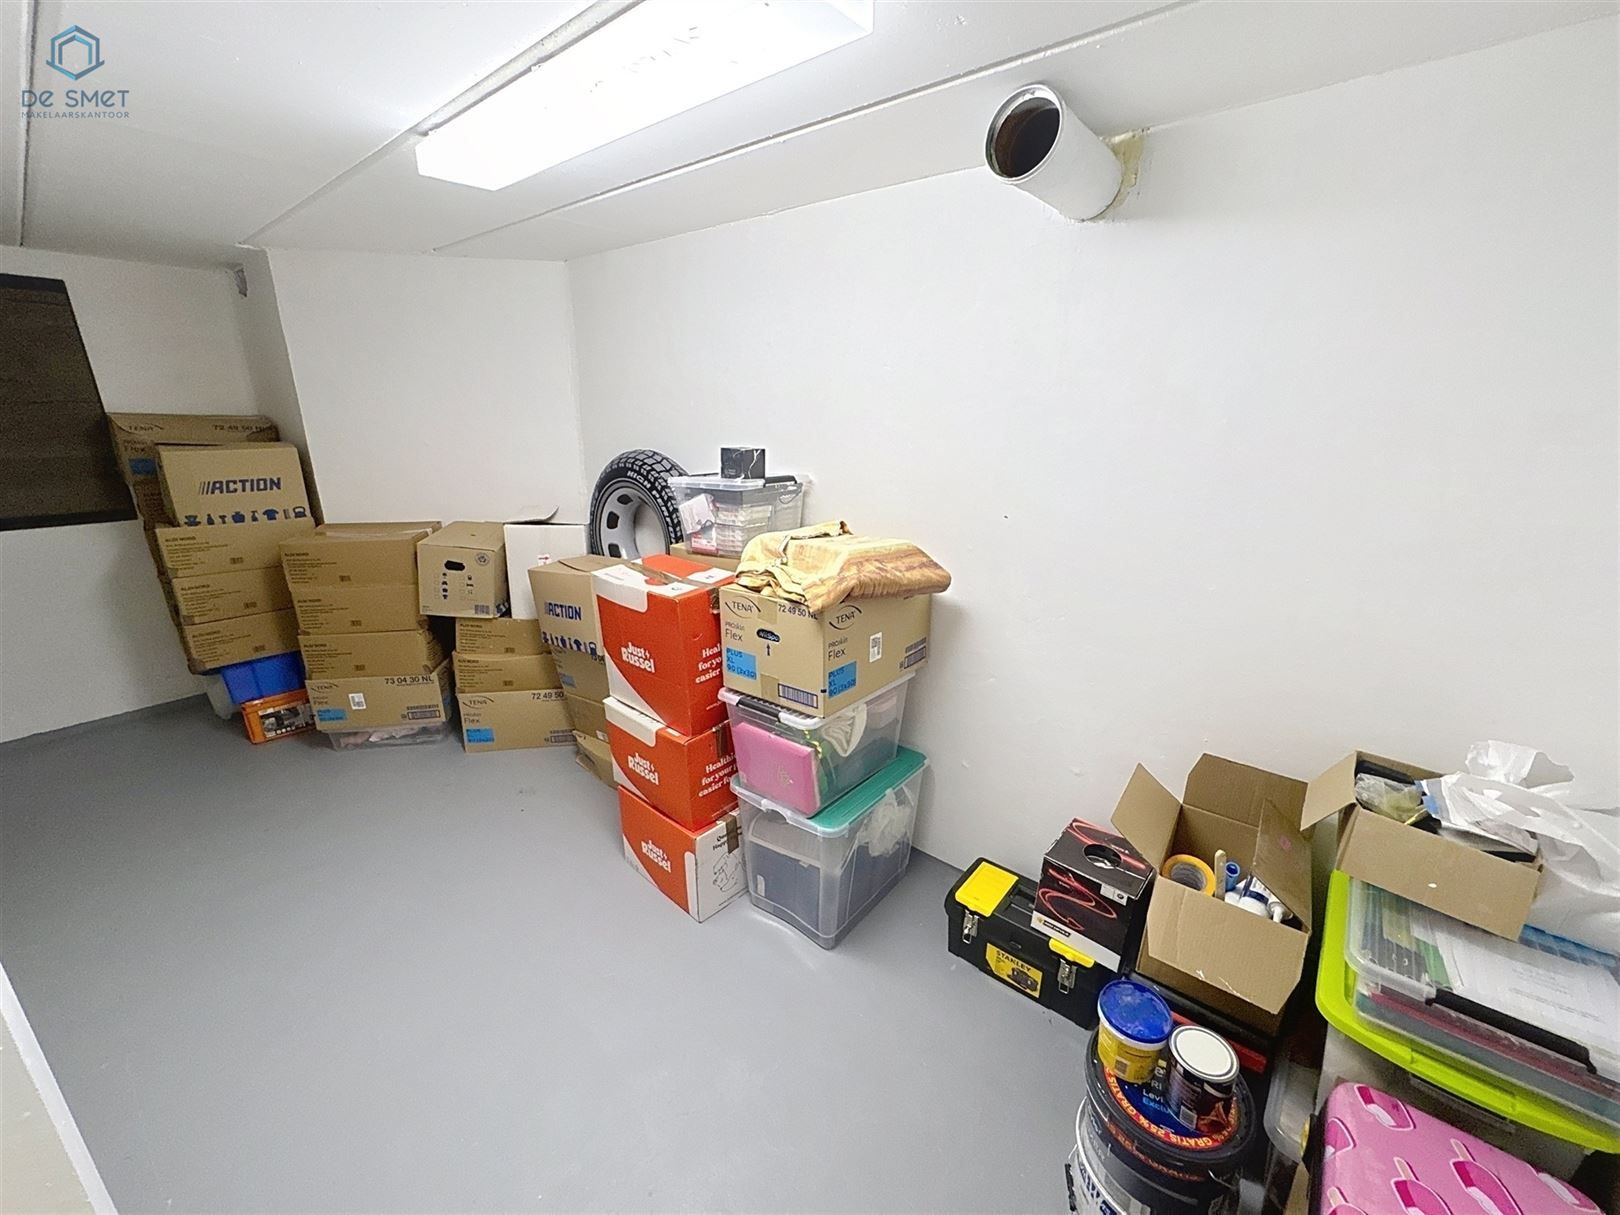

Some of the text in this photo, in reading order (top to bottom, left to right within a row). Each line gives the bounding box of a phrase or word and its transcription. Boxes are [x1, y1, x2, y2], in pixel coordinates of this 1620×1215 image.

[210, 477, 281, 495] ACTION
[626, 470, 651, 489] HIGH
[548, 602, 582, 621] ACTION
[732, 600, 753, 613] TENA
[778, 603, 788, 613] 72
[787, 606, 797, 616] 49
[797, 608, 806, 617] 50
[835, 609, 856, 625] TENA
[725, 628, 743, 642] Flex
[627, 641, 645, 657] Just
[828, 648, 846, 662] Flex
[620, 646, 655, 673] Russel
[698, 660, 712, 672] for
[384, 677, 395, 685] 73
[396, 676, 407, 684] 04
[695, 667, 721, 684] easier
[531, 692, 541, 700] 72
[543, 691, 553, 699] 49
[634, 752, 651, 770] Just
[627, 754, 659, 786] Russel
[701, 774, 715, 786] for
[698, 782, 722, 798] easier
[640, 840, 671, 873] Russel
[646, 839, 665, 860] Just
[996, 950, 1032, 972] STANLEY
[1108, 1075, 1138, 1116] GRATIS
[1142, 1088, 1164, 1103] Levi
[1138, 1116, 1167, 1137] 25%
[1169, 1133, 1213, 1148] GRATIS
